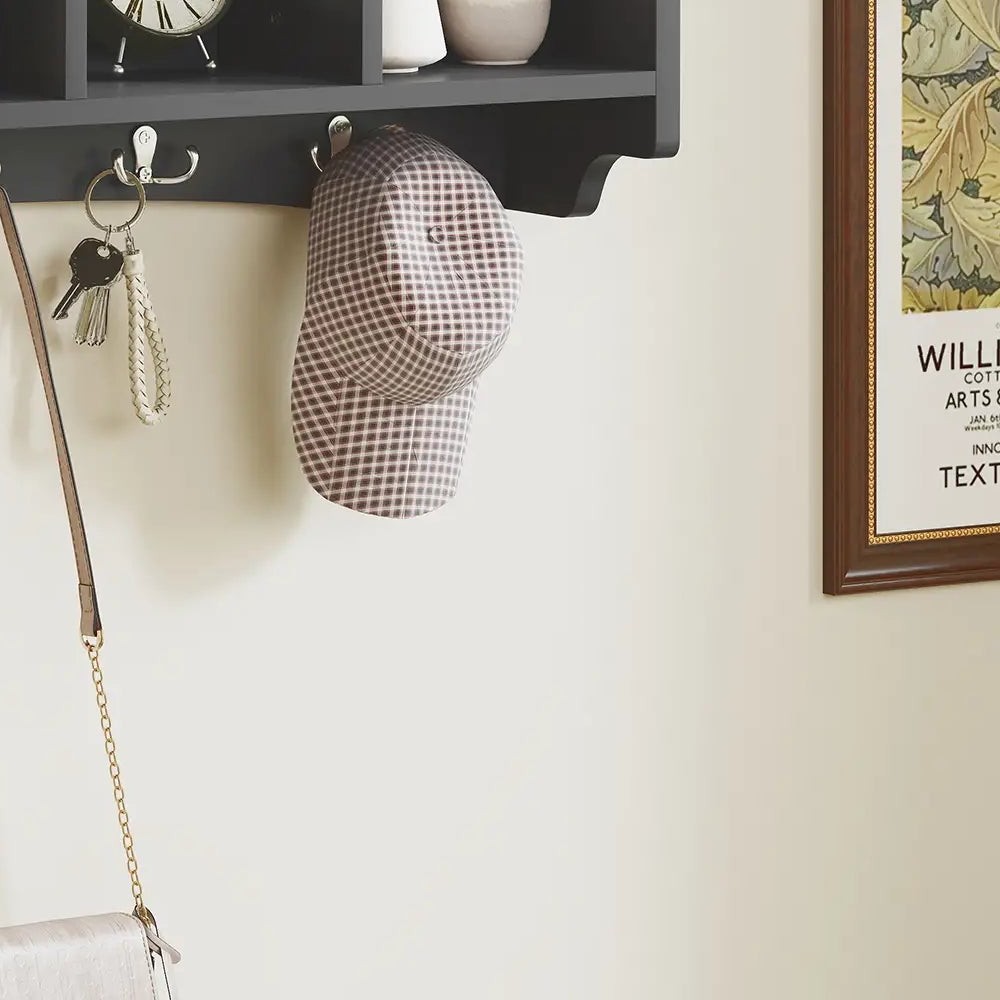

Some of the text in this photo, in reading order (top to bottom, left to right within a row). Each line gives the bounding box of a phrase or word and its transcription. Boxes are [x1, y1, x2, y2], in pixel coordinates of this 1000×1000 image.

[964, 370, 1000, 384] COTT
[945, 389, 991, 409] ARTS
[939, 462, 1000, 488] TEXT
